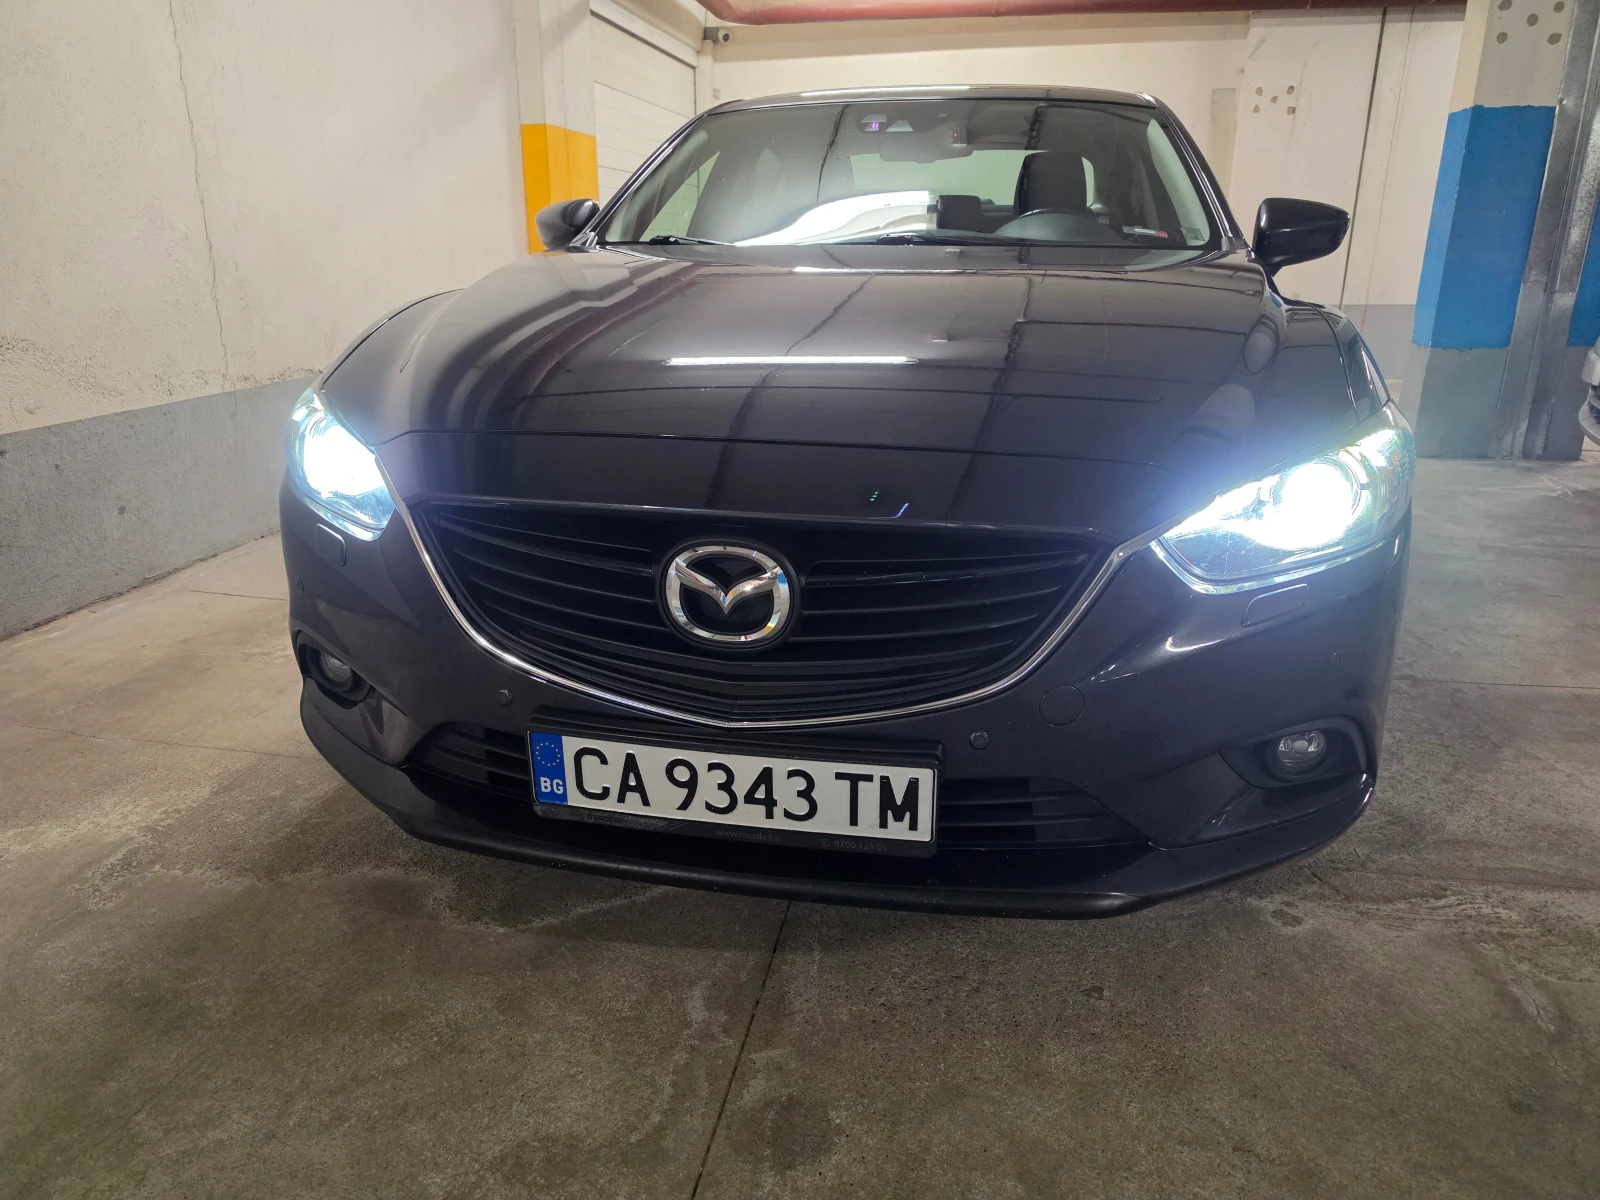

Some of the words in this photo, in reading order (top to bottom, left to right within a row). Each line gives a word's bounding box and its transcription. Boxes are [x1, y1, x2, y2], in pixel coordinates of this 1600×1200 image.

[540, 777, 564, 794] BG
[573, 746, 651, 807] CA
[665, 758, 818, 821] 9343
[834, 771, 919, 831] TM
